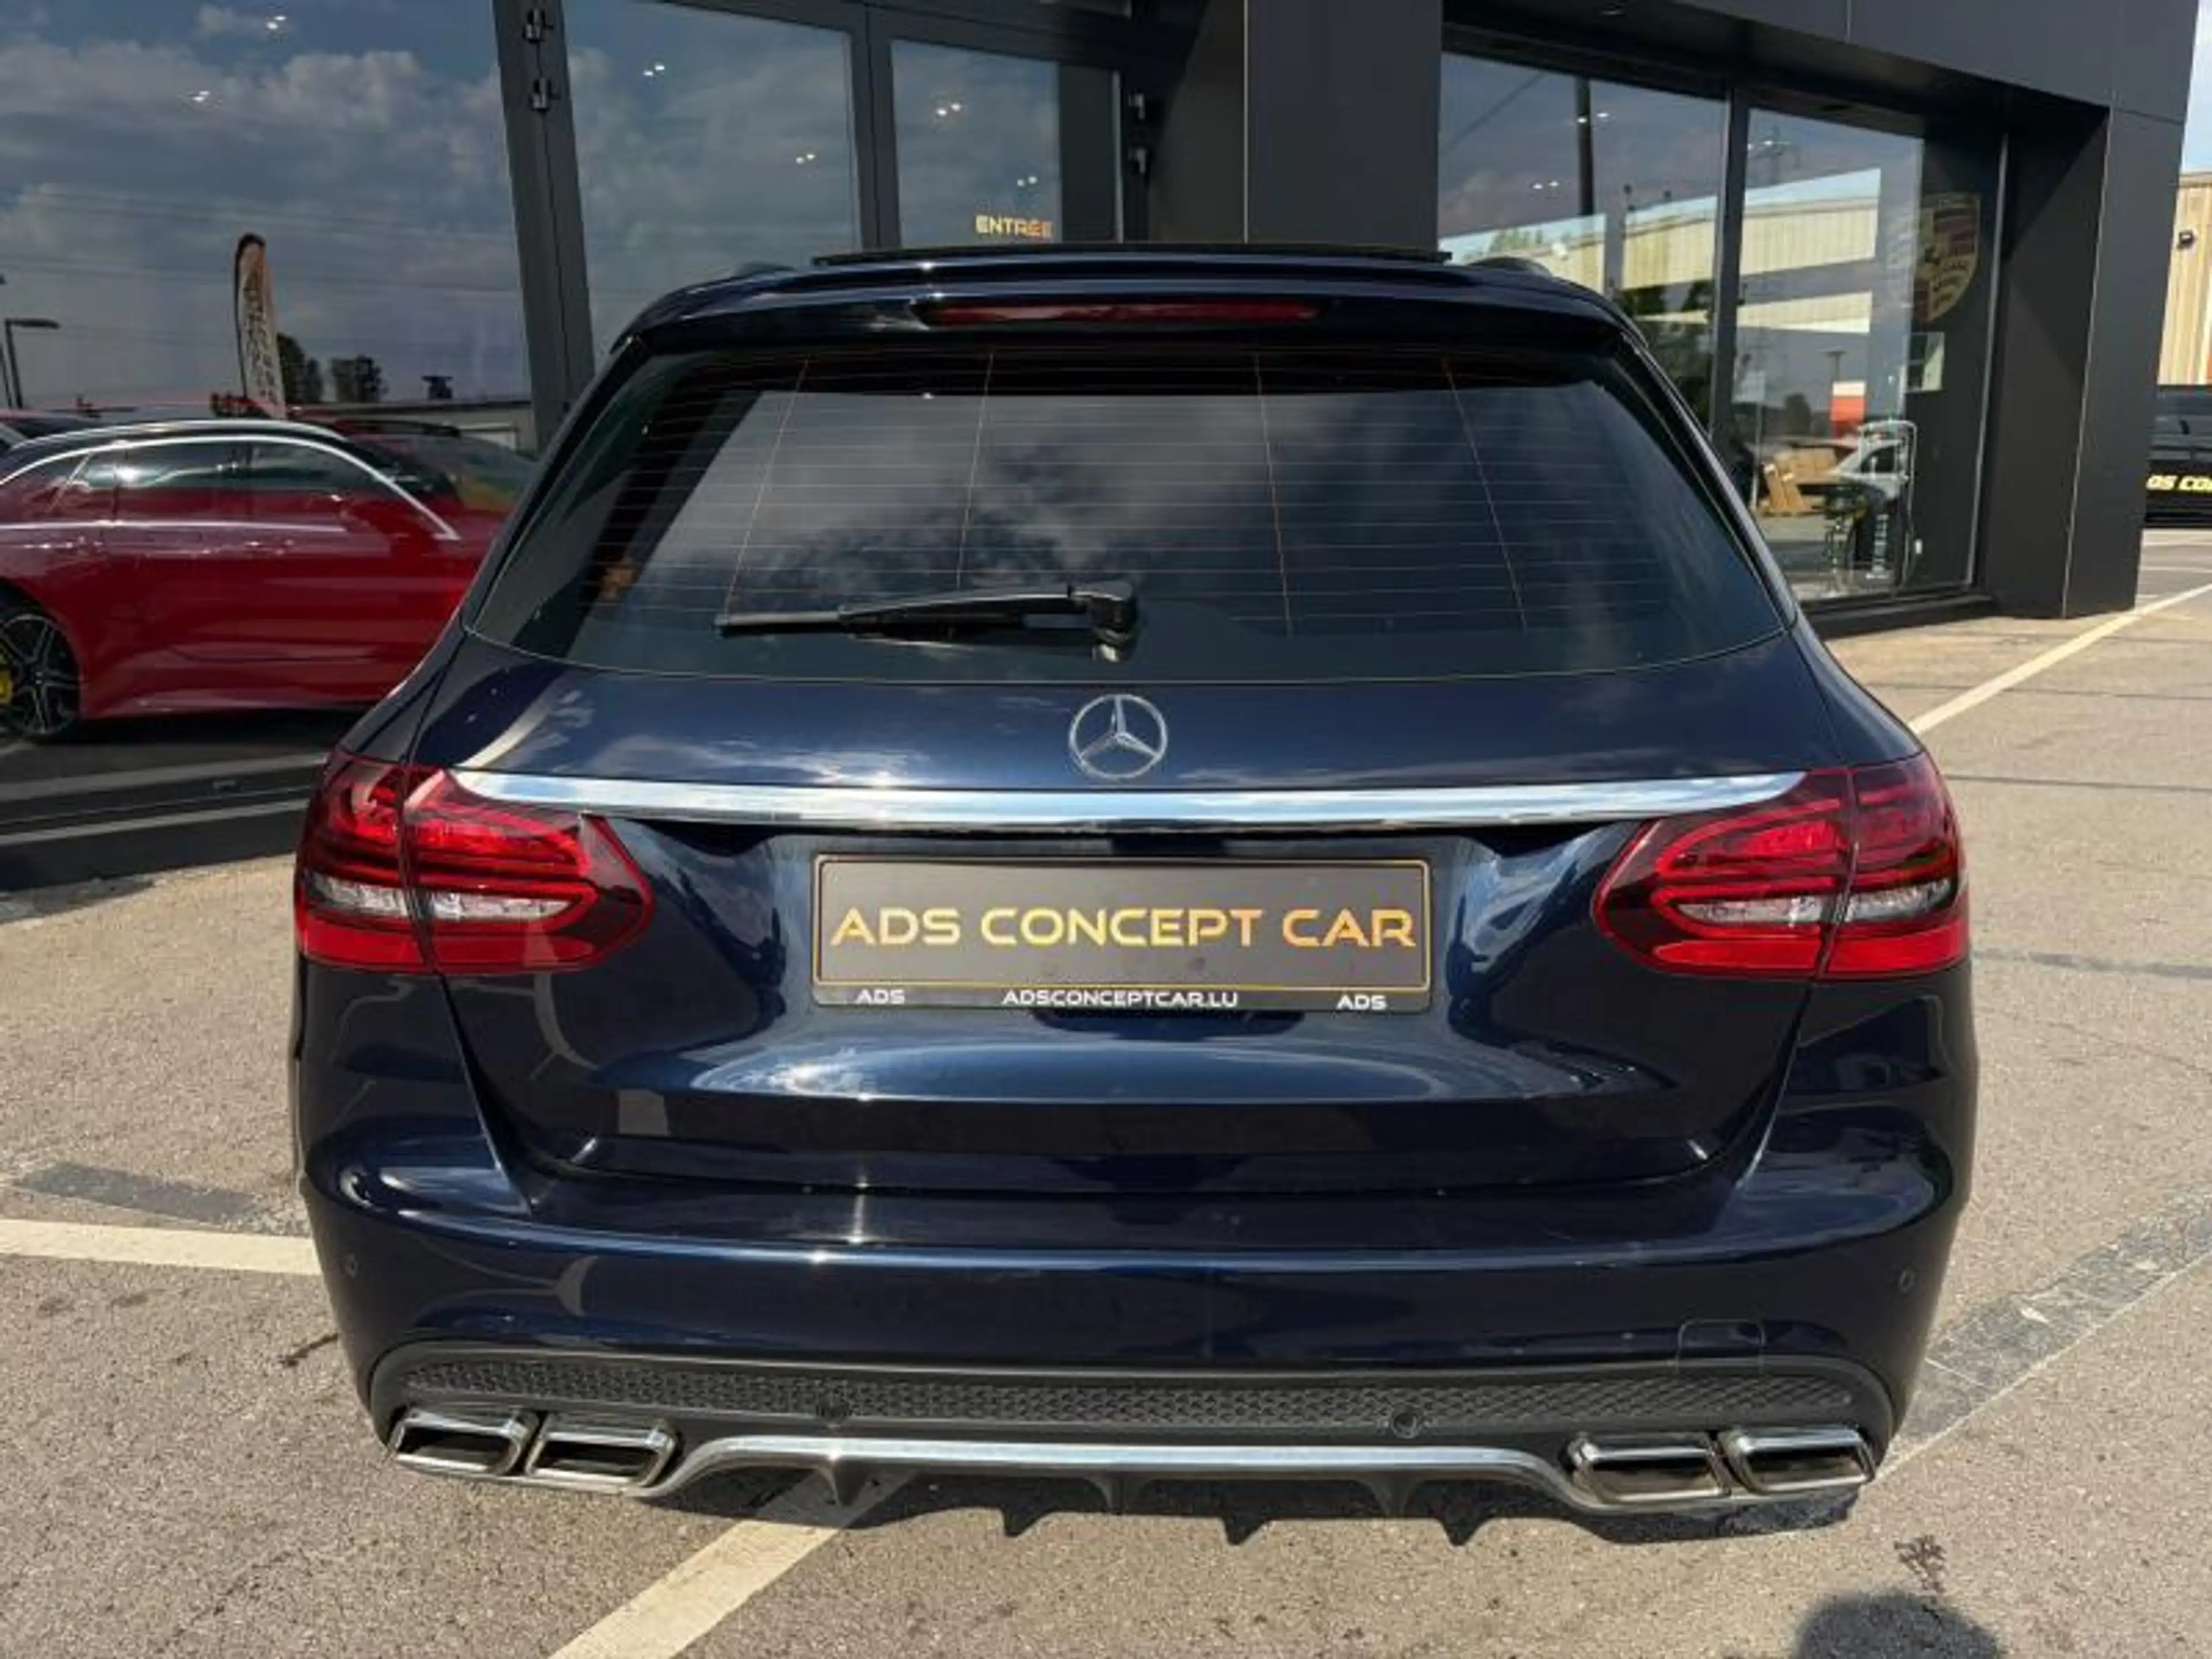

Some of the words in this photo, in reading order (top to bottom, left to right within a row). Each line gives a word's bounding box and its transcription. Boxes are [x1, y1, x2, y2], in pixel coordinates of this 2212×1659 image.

[830, 907, 961, 946] ADS
[980, 907, 1263, 947] CONCEPT
[1282, 908, 1416, 948] CAR
[856, 988, 906, 1005] ADS
[1003, 989, 1238, 1007] ADSCONCEPTCAR.LU
[1336, 994, 1387, 1010] ADS
